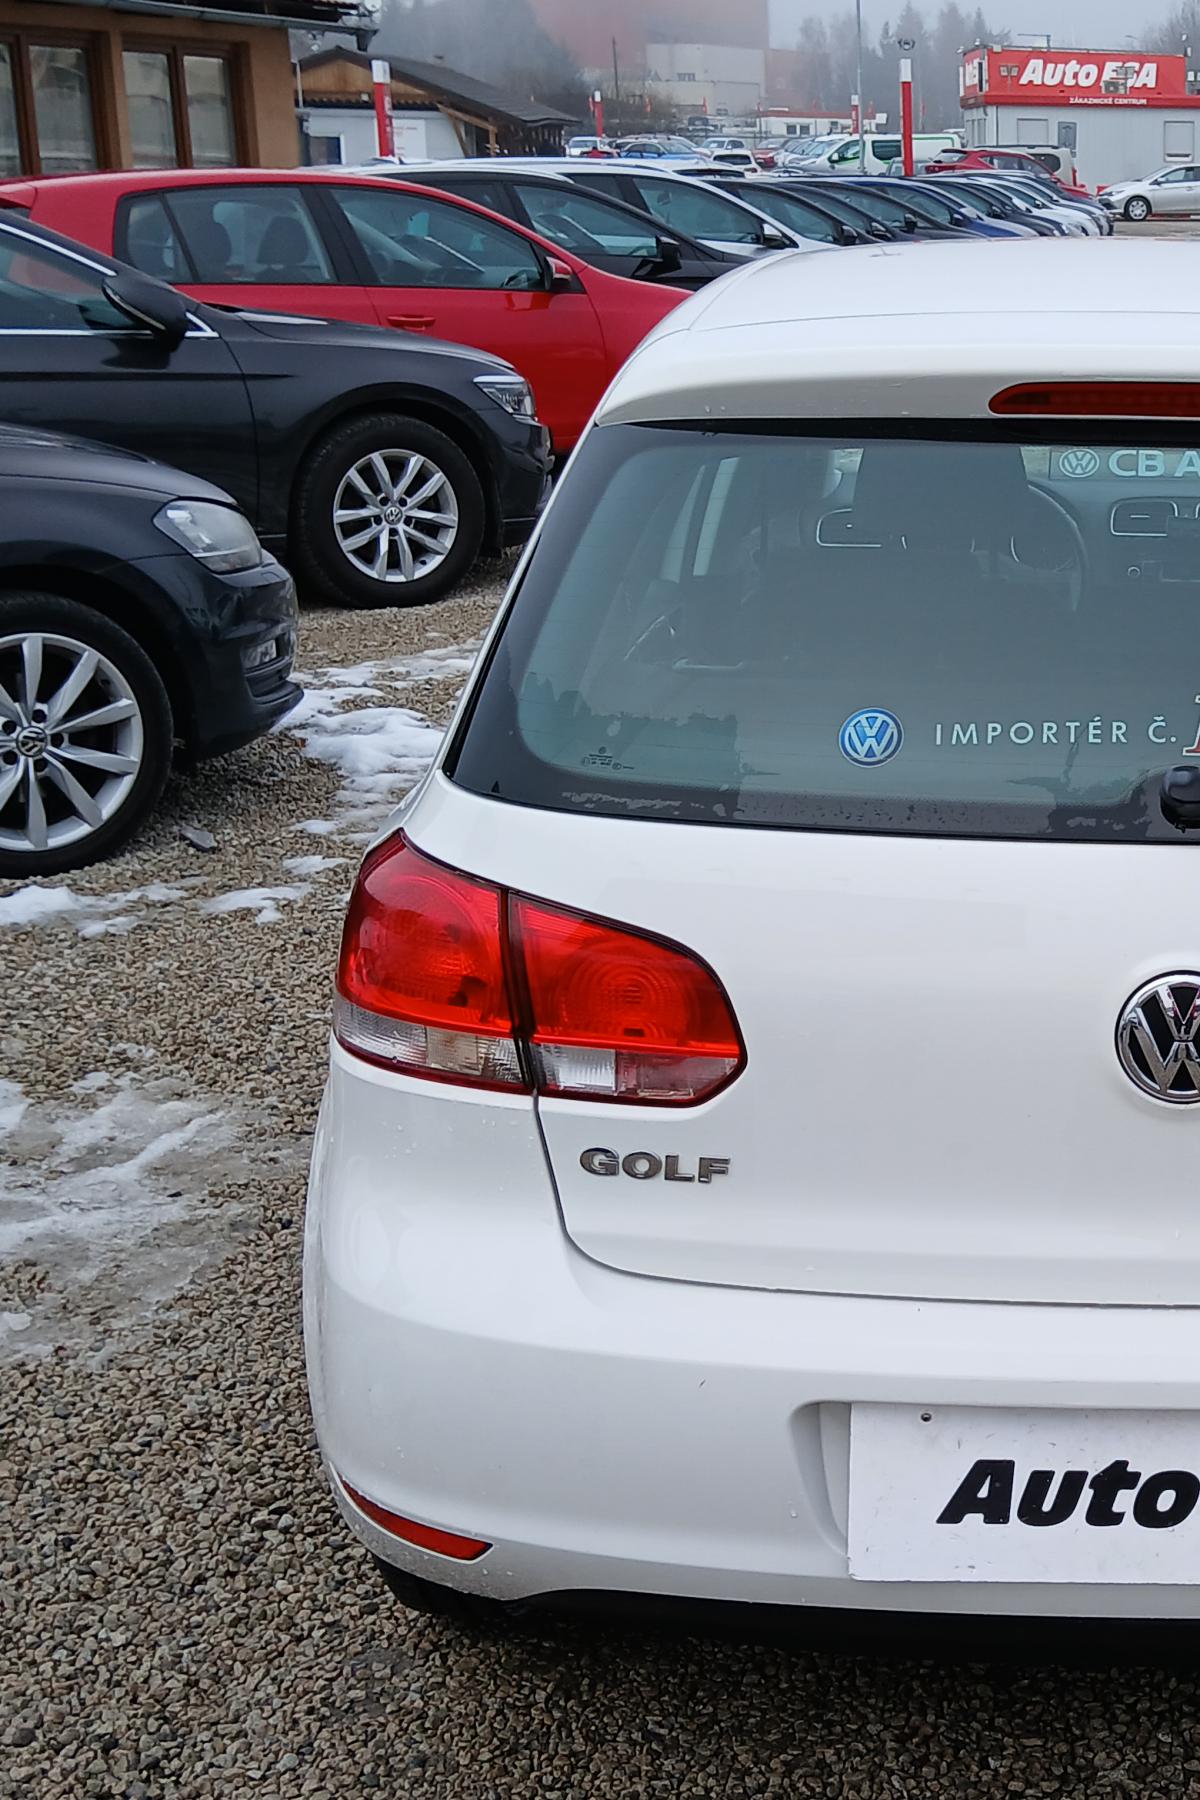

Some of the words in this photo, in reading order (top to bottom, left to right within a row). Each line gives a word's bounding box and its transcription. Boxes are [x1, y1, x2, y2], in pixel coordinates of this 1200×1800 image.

[1018, 58, 1099, 88] Auto
[1108, 449, 1165, 477] CB
[935, 715, 1128, 746] IMPORTÉR
[1147, 716, 1177, 744] Č.
[579, 1147, 731, 1184] GOLF
[935, 1458, 1200, 1529] Auto
